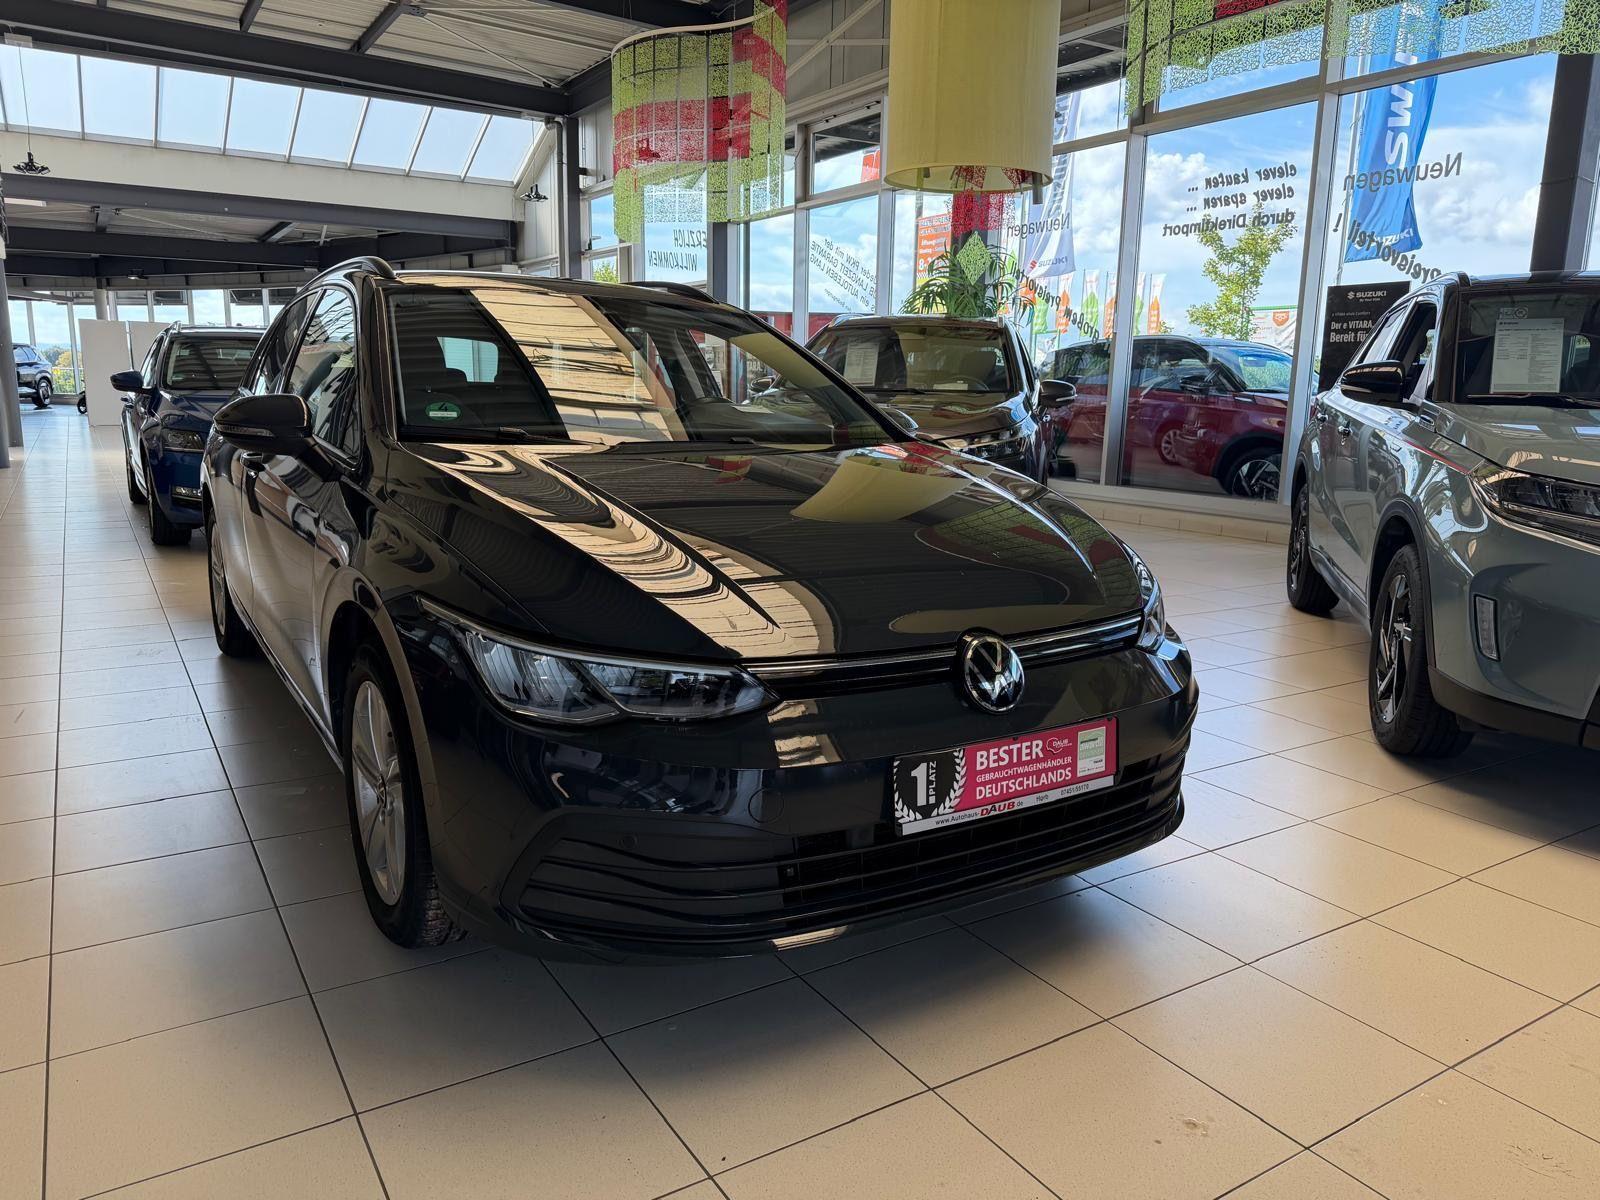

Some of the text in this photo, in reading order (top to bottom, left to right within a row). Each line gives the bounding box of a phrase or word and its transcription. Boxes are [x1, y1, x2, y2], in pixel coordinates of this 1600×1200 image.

[1355, 290, 1387, 298] SUZUKI
[1330, 331, 1354, 343] Bereit
[976, 739, 1044, 771] BESTER
[976, 756, 1072, 783] GEBRAUCHTWAGENHÄNDLER
[928, 760, 937, 798] PLATZ
[976, 767, 1072, 800] DEUTSCHLANDS
